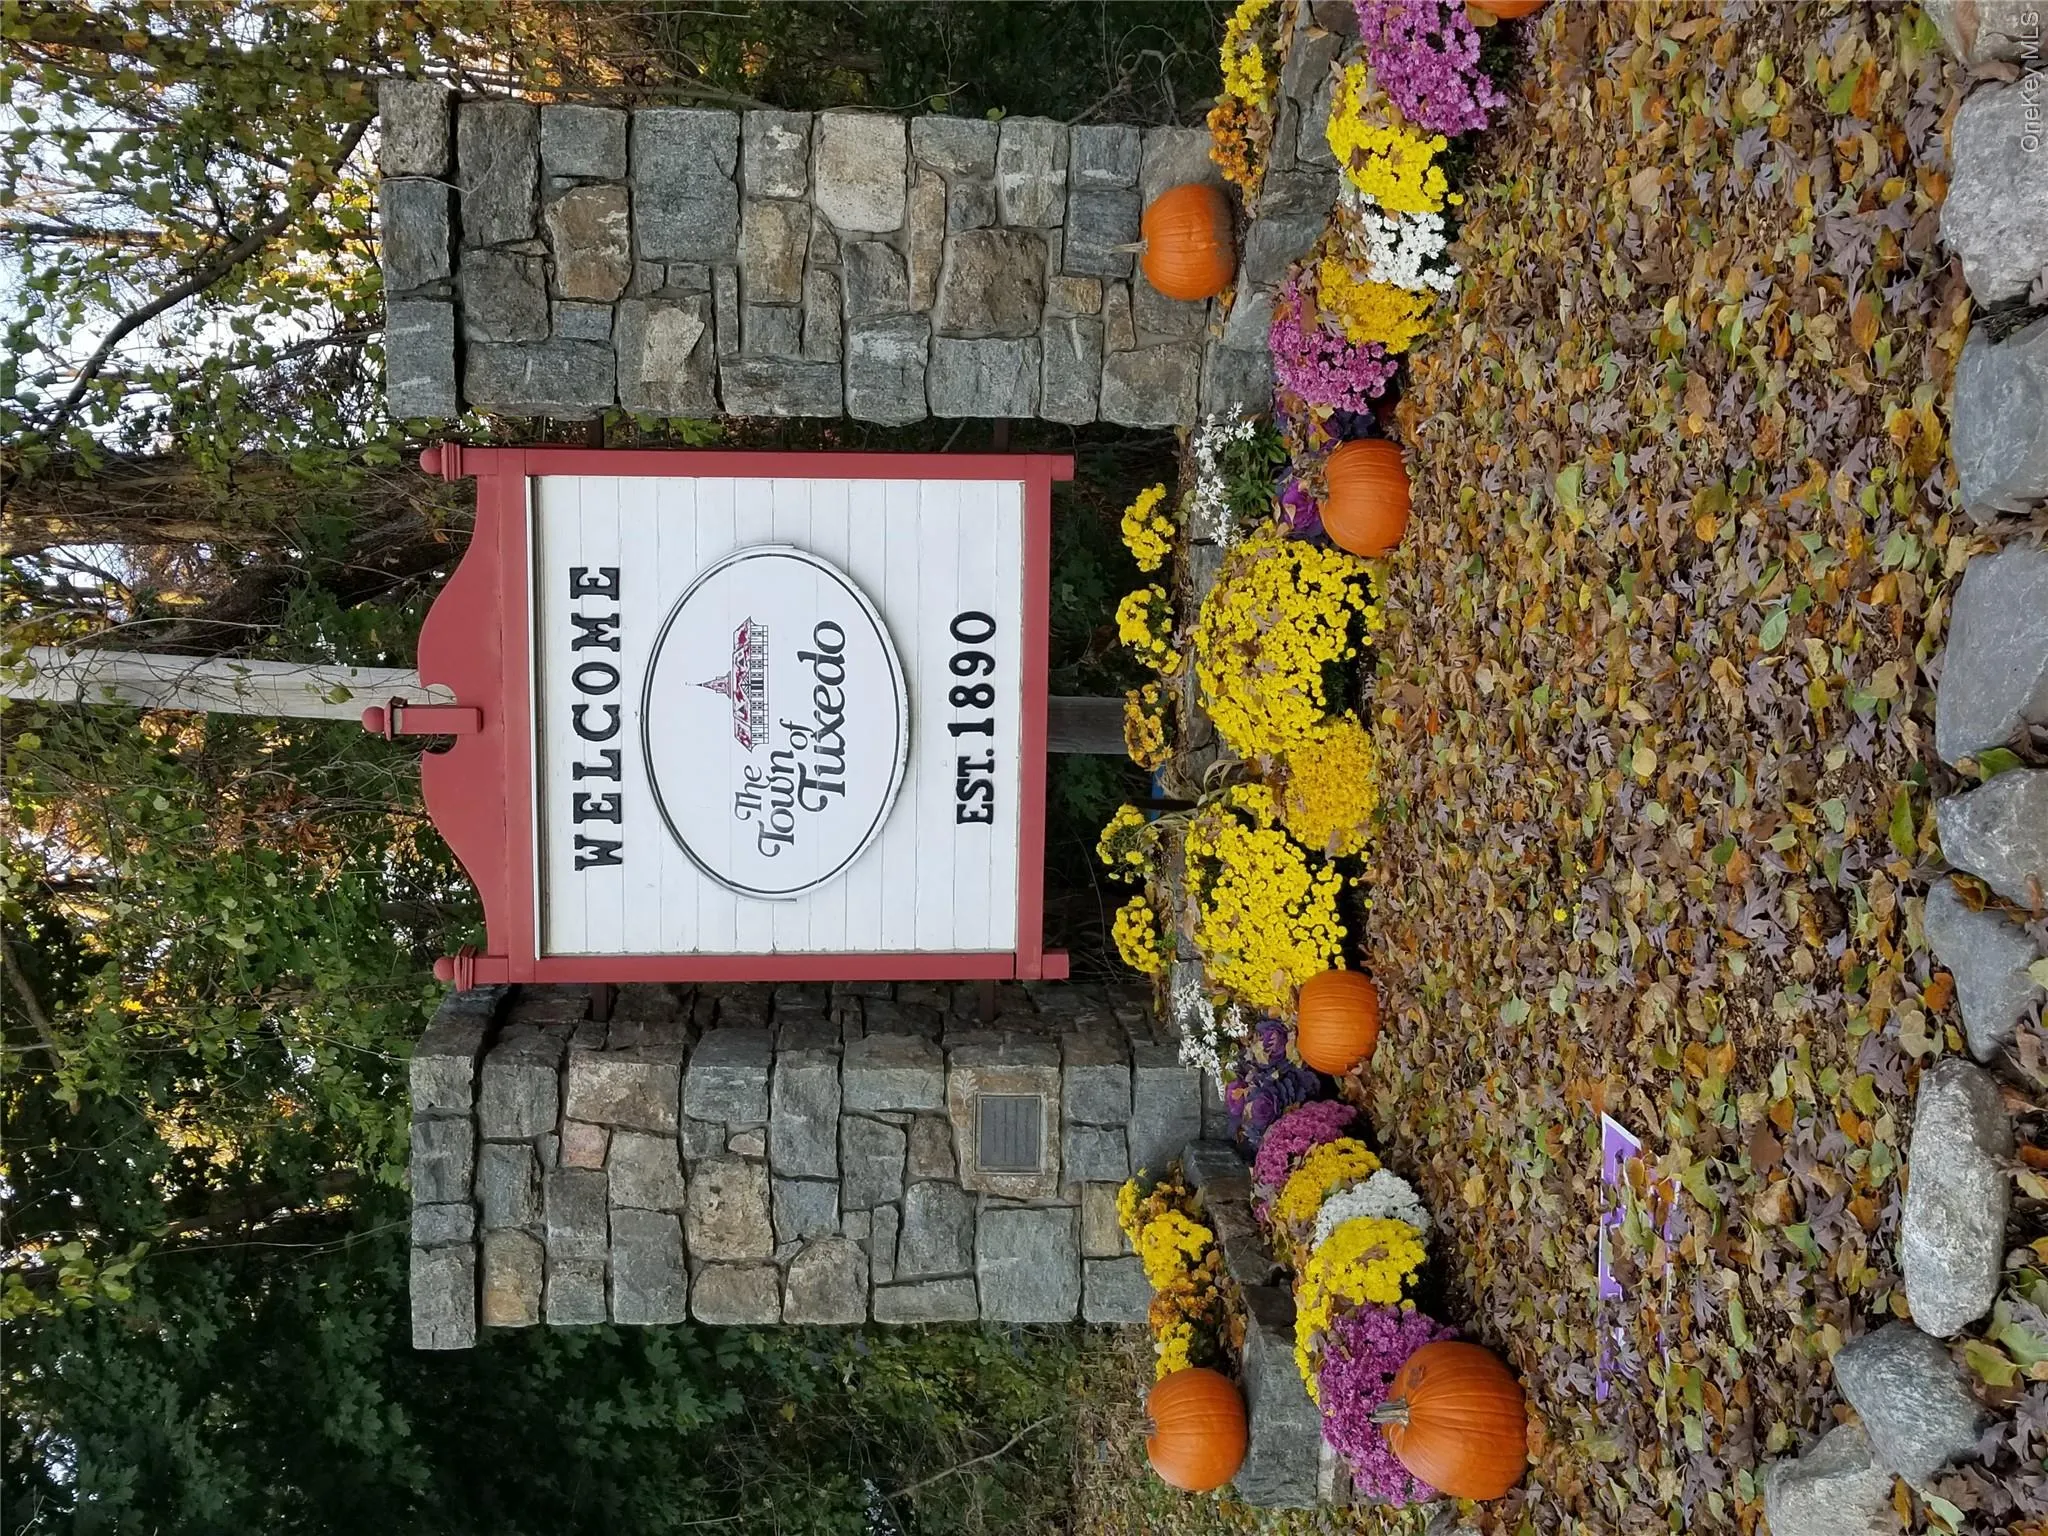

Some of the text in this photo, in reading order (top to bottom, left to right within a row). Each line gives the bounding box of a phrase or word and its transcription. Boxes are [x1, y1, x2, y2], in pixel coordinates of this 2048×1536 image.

[569, 567, 623, 871] WELCOME
[734, 765, 769, 821] The
[757, 718, 814, 857] Town of
[797, 620, 846, 812] Tuxedo
[948, 611, 996, 824] EST. 1890
